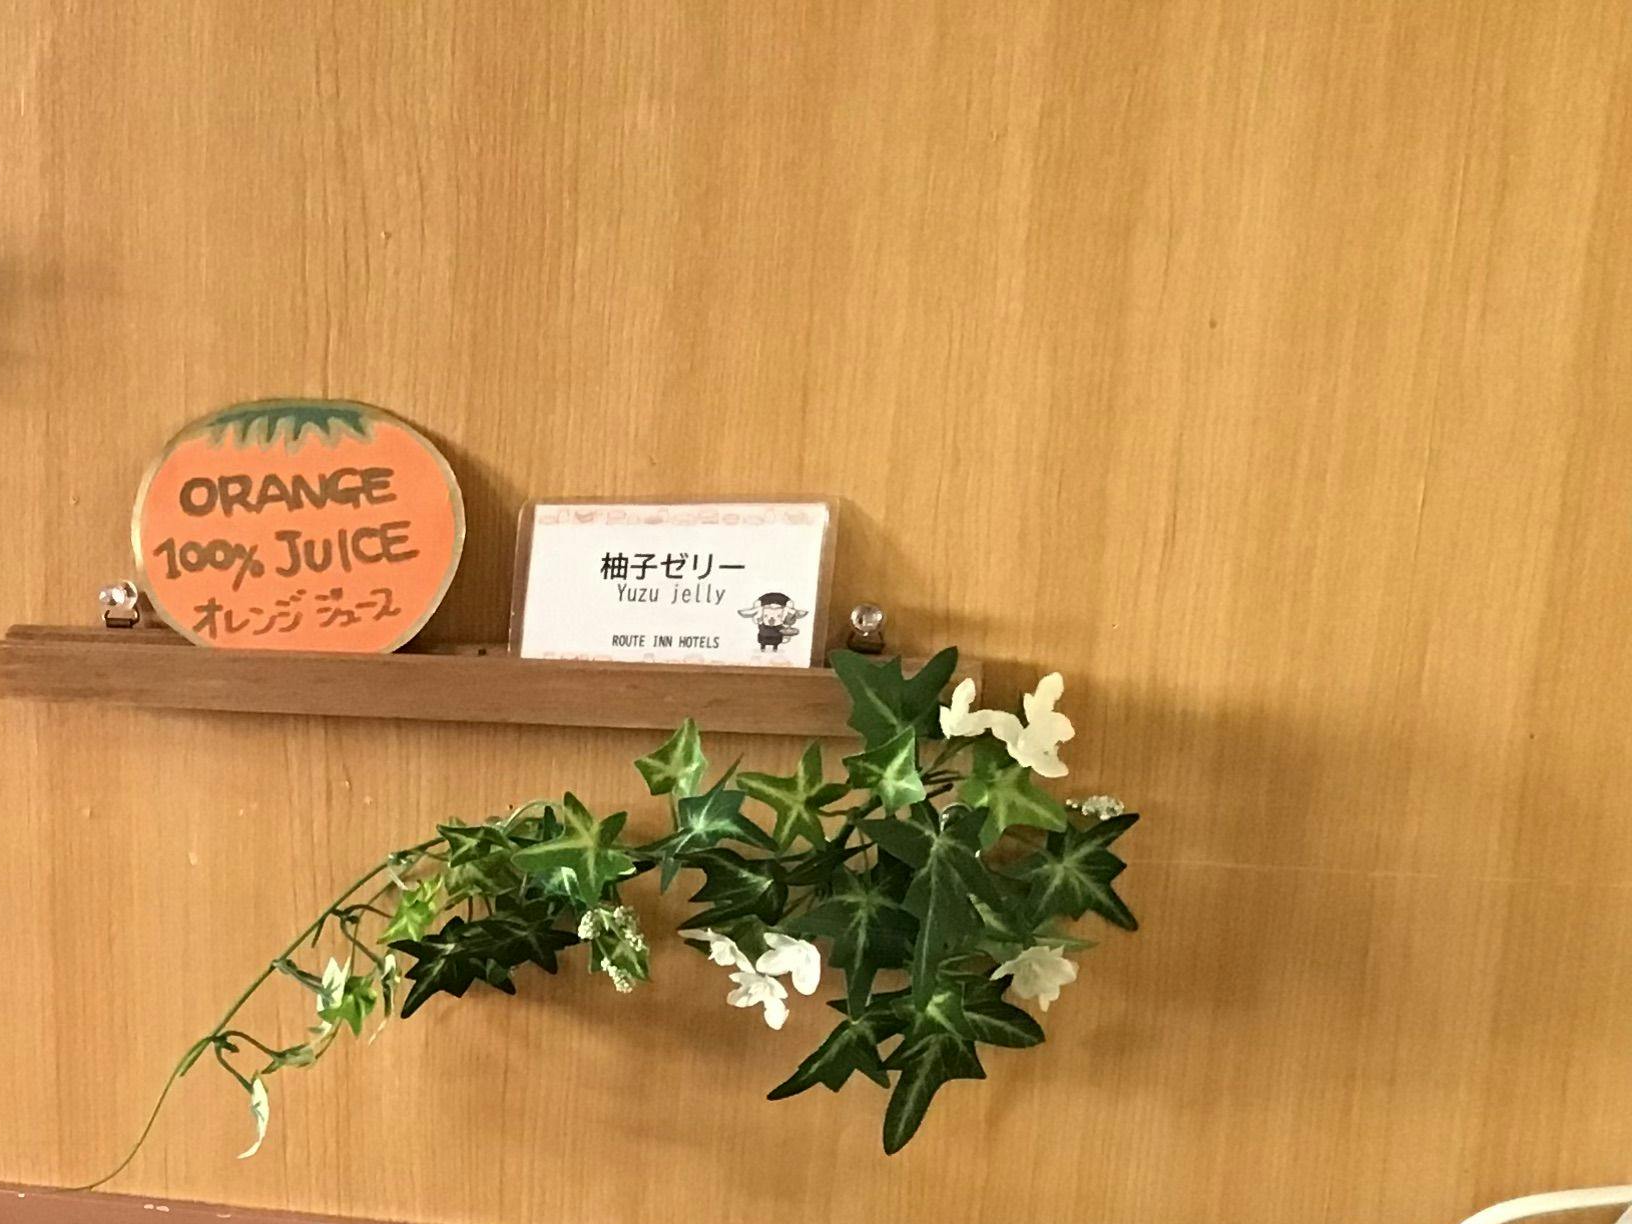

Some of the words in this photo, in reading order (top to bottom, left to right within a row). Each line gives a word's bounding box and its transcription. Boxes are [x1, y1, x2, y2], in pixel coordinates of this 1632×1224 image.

[178, 466, 398, 519] ORANGE
[152, 536, 266, 593] 100%
[274, 519, 421, 578] JUICE
[600, 551, 746, 581] 柚子ゼリー
[617, 582, 660, 603] Yuzu
[670, 582, 727, 606] jelly
[611, 634, 646, 648] ROUTE
[652, 635, 673, 649] INN
[678, 635, 720, 650] HOTELS
